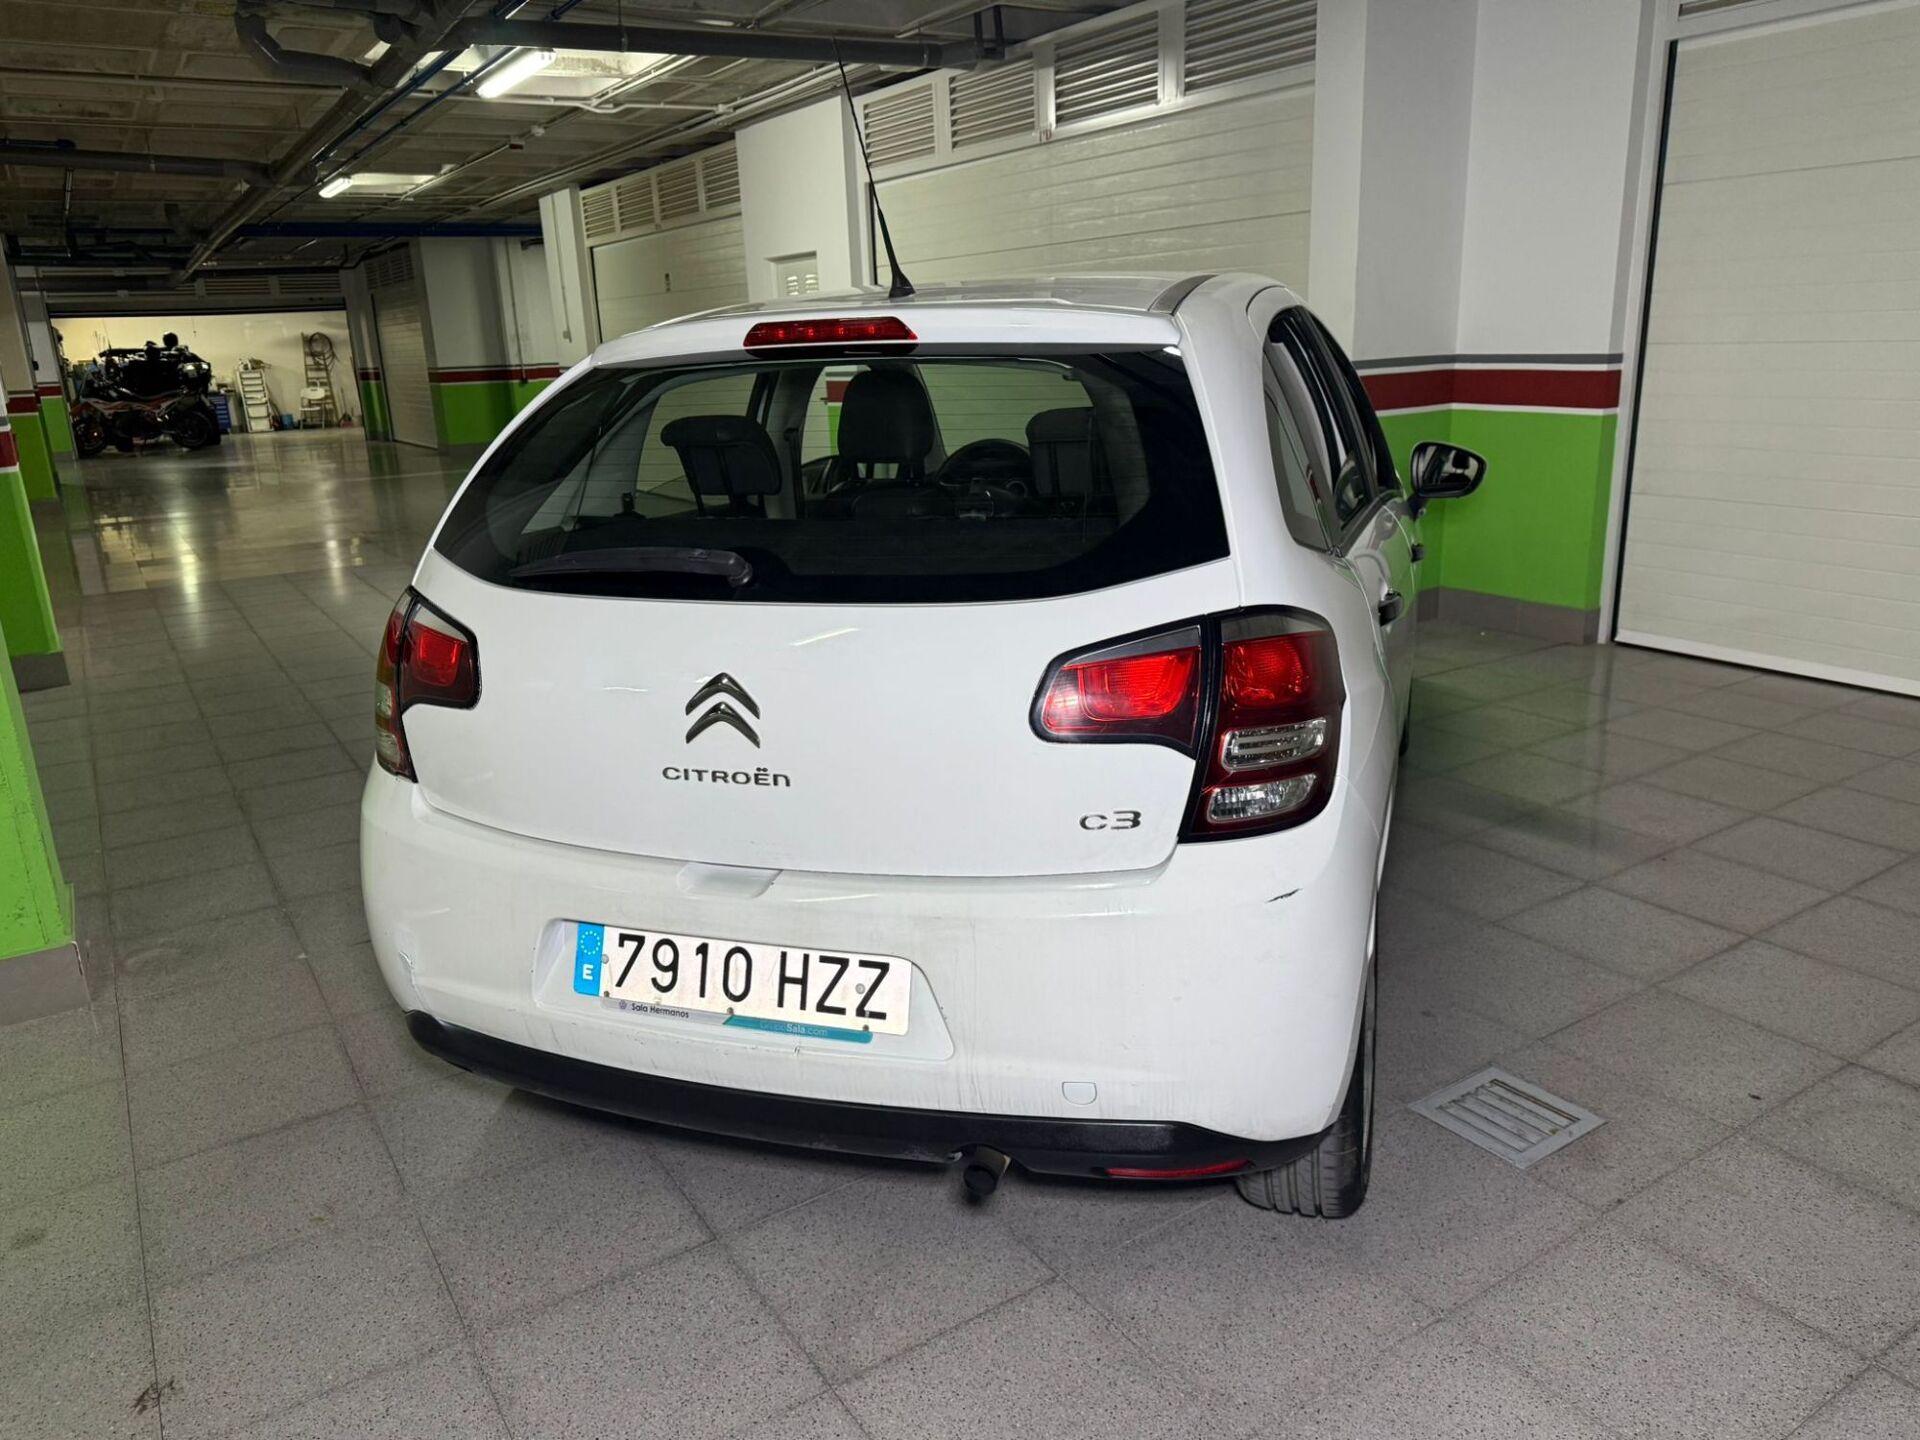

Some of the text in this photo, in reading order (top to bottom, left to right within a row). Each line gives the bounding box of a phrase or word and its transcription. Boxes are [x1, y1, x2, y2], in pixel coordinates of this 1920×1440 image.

[1079, 810, 1141, 830] C3
[582, 963, 594, 980] E
[615, 933, 890, 1020] 7910 HZZ
[631, 1002, 689, 1019] Sala Hermanos
